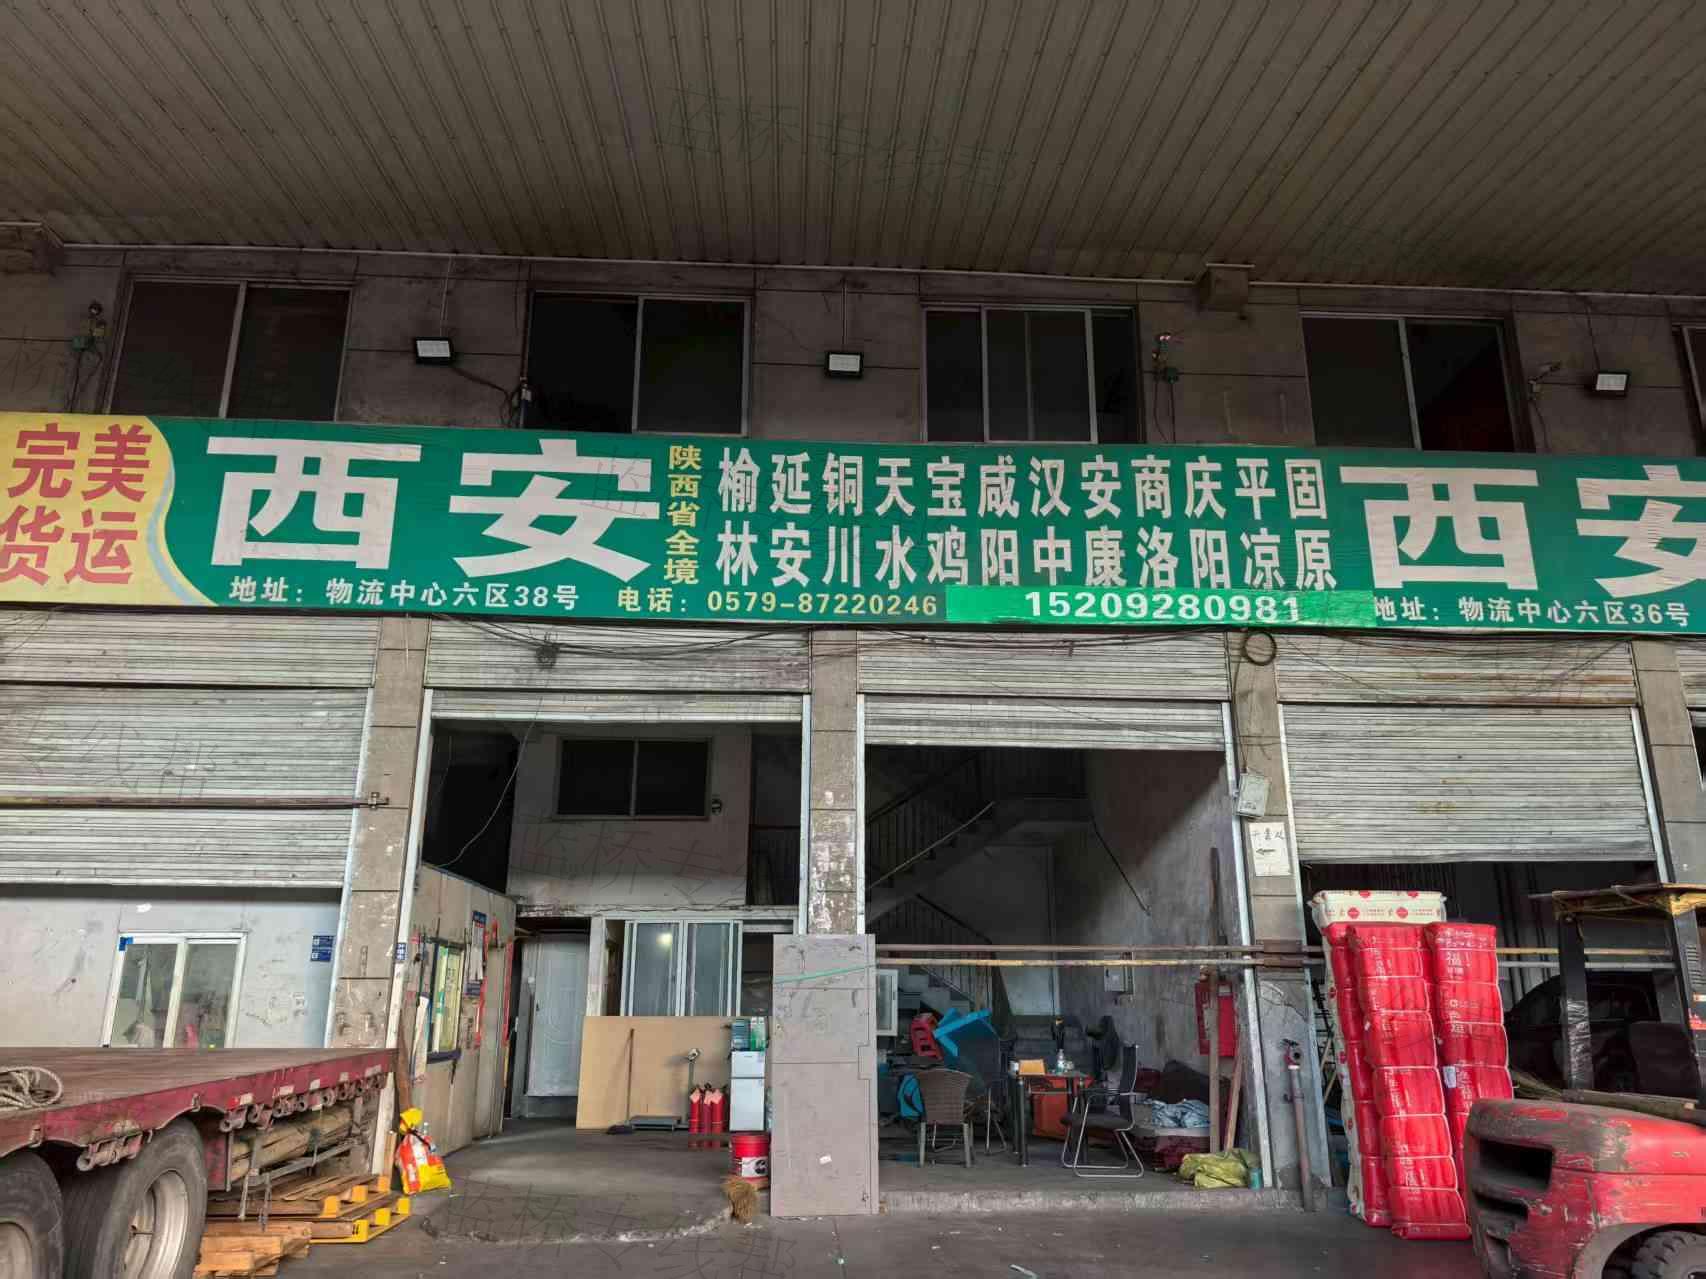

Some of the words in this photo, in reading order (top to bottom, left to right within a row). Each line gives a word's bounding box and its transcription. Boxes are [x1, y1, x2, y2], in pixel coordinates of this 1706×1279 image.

[8, 422, 153, 503] 完美
[0, 504, 139, 587] 货运
[207, 436, 660, 583] 西安
[663, 445, 702, 585] 陕西省全境
[1024, 591, 1301, 623] 15209280981
